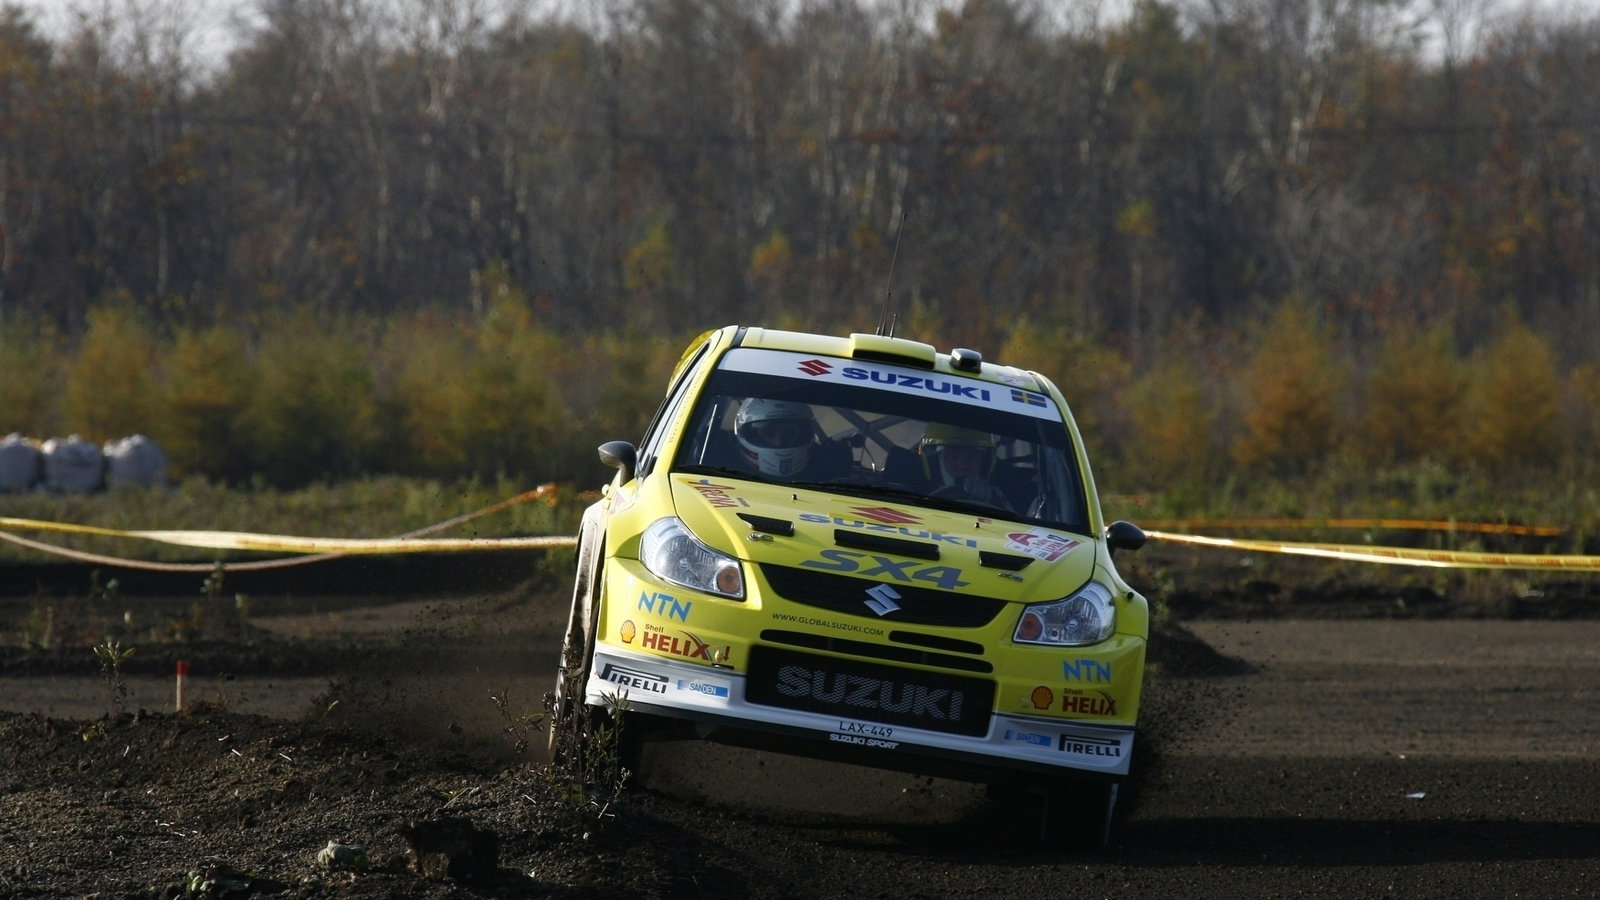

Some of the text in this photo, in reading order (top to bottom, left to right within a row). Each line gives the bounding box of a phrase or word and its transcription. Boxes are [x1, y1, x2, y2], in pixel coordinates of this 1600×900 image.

[842, 367, 990, 402] SUZUKI
[799, 513, 977, 548] SUZUKI
[799, 549, 970, 590] SX4
[638, 590, 692, 623] NTN
[645, 623, 664, 633] Shell
[772, 612, 884, 637] WWW.GLOBALSUZUKI.COM
[642, 630, 712, 662] HELIX
[599, 663, 670, 694] PIRELLI
[1062, 659, 1111, 683] NTN
[689, 682, 717, 695] SANDEN
[776, 665, 965, 721] SUZUKI
[1064, 688, 1083, 696] Shell
[1062, 691, 1117, 716] HELIX
[829, 733, 899, 750] SUZUKI SPORT
[839, 720, 893, 738] LAX-449
[1058, 733, 1121, 757] PIRELLI
